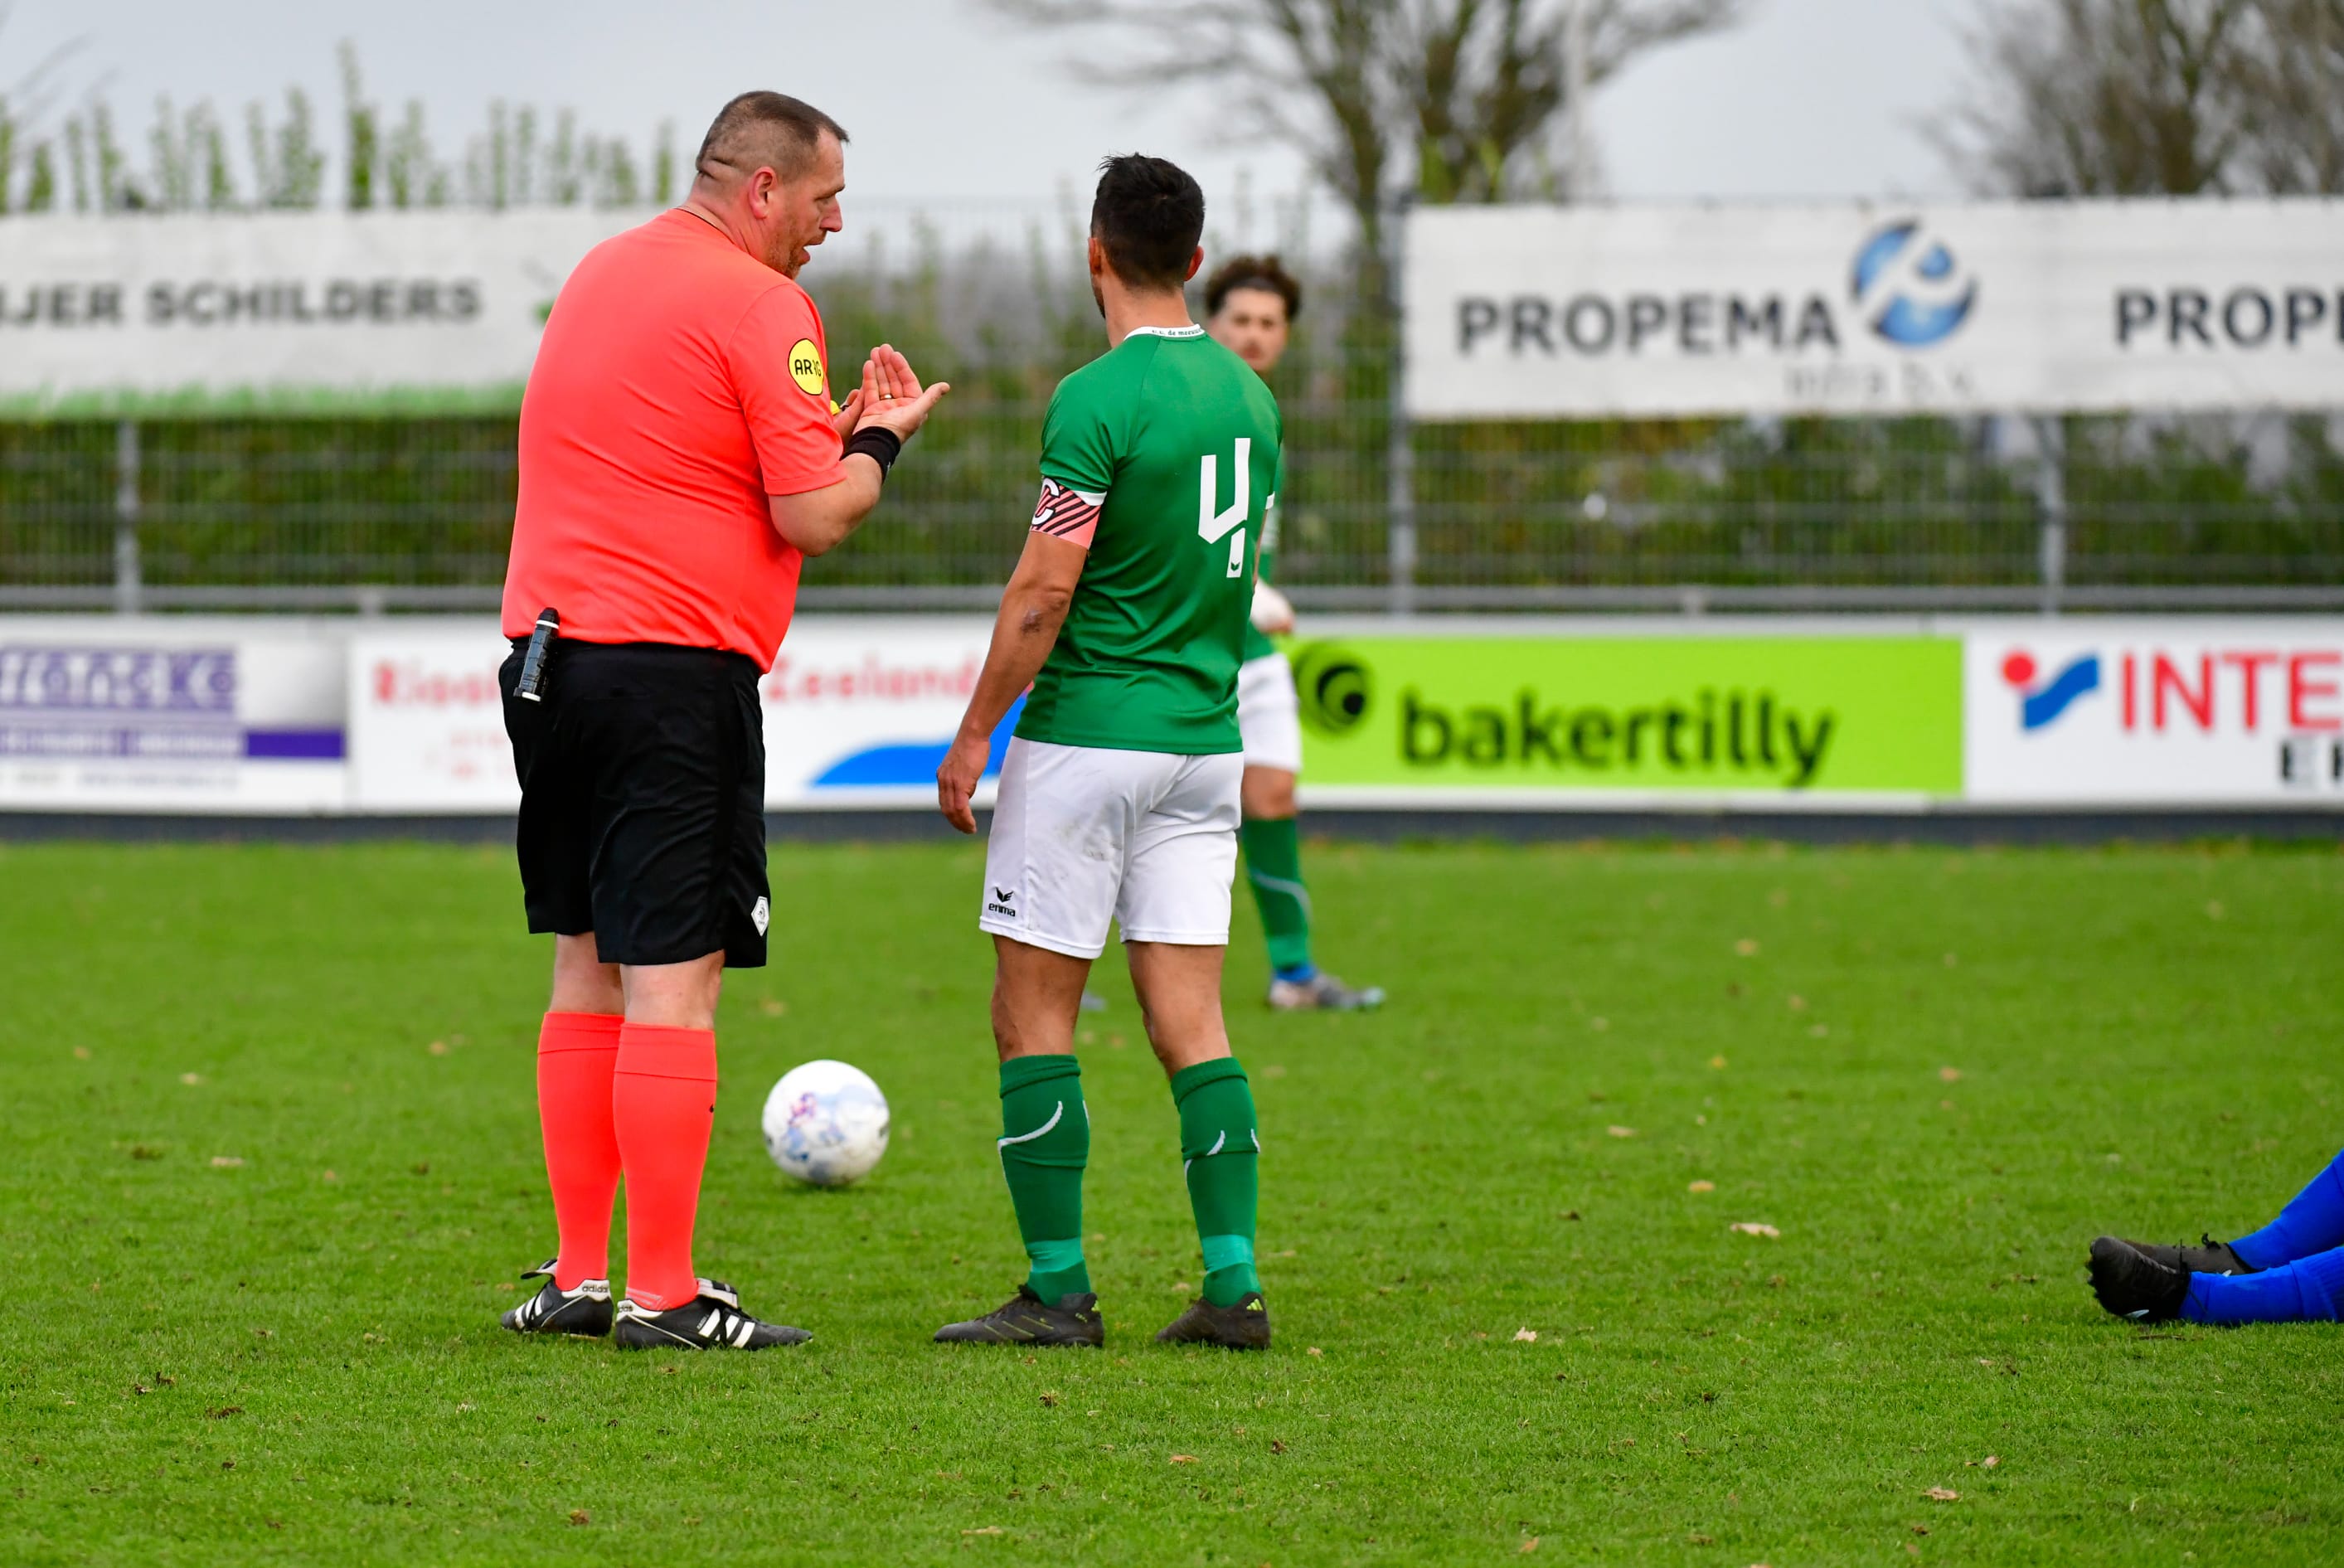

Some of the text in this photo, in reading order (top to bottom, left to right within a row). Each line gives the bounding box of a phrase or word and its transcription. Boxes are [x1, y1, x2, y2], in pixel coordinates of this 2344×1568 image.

[145, 279, 481, 323] SCHILDERS
[1455, 294, 1840, 355] PROPEMA
[2115, 287, 2344, 348] PROP
[1197, 437, 1251, 578] 4
[2121, 650, 2344, 732] INTE
[1400, 687, 1837, 789] bakertilly
[988, 902, 1016, 917] erima
